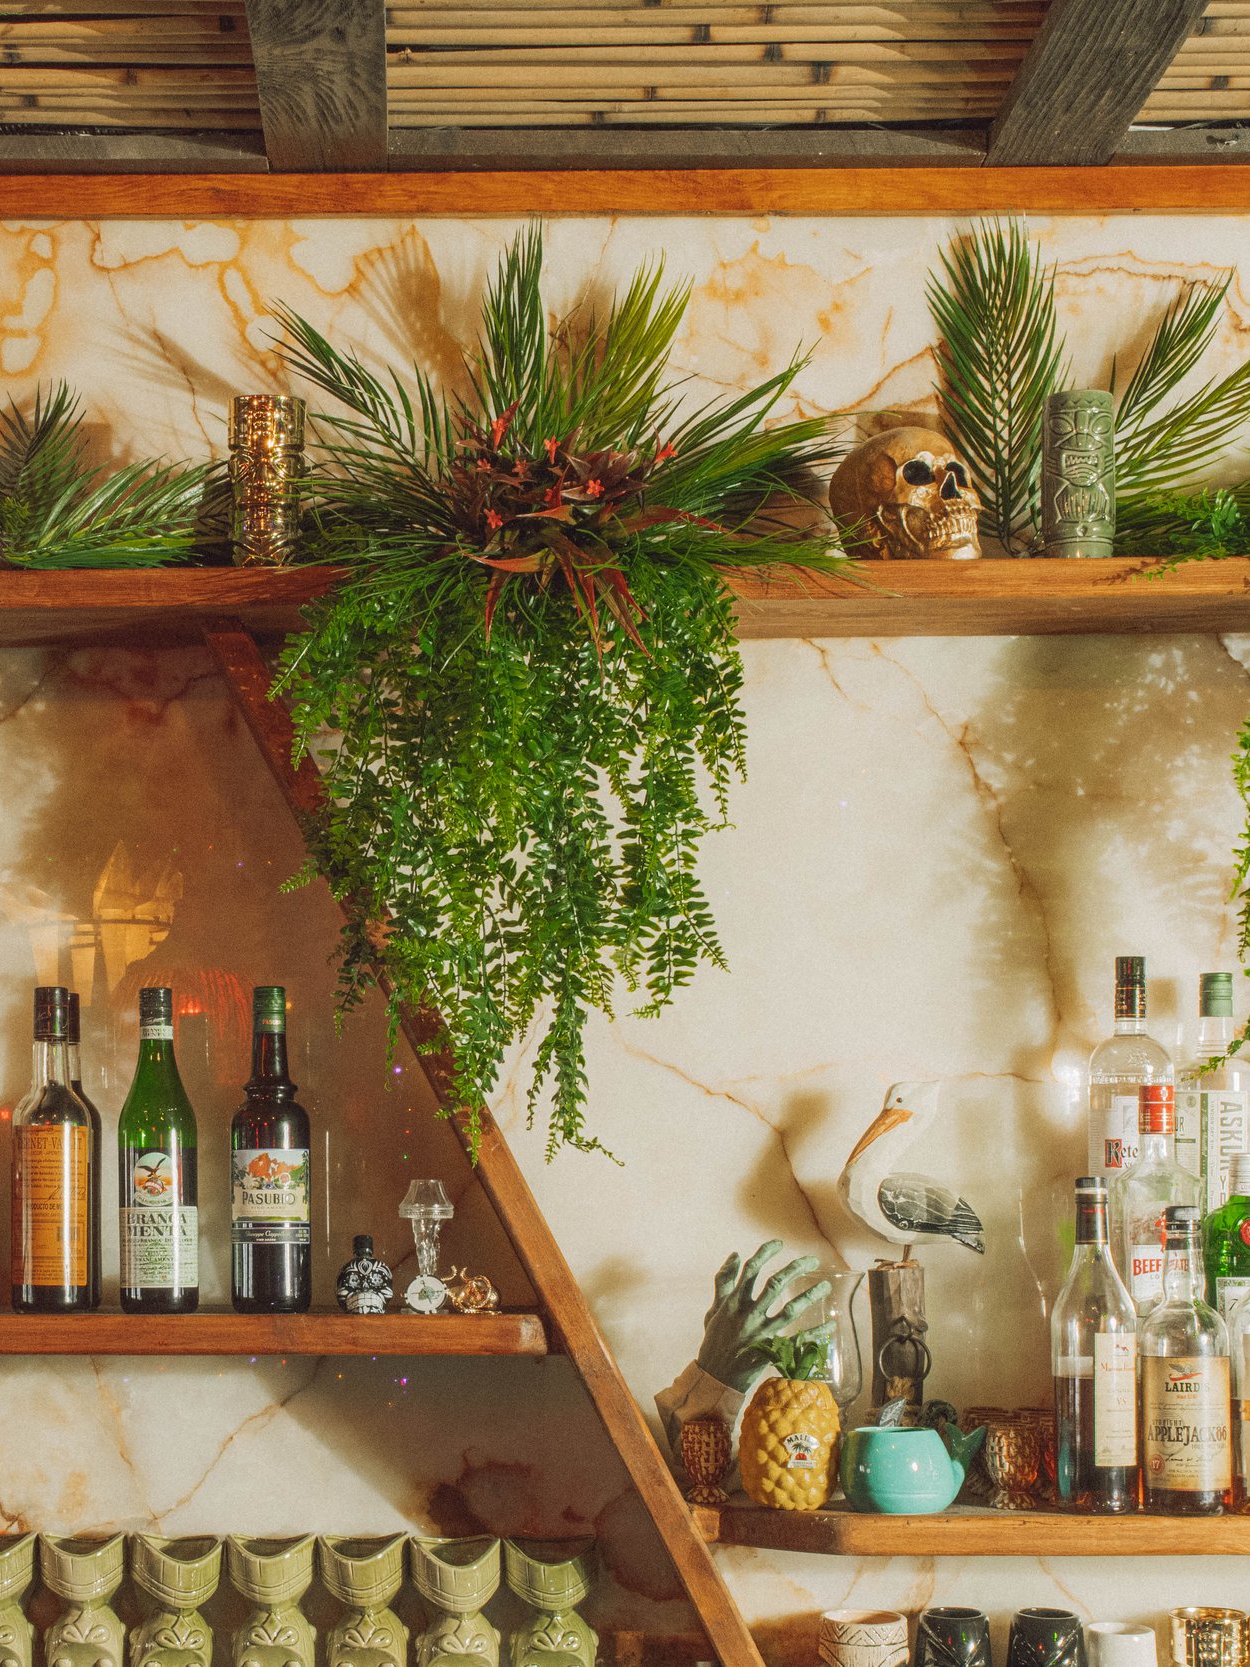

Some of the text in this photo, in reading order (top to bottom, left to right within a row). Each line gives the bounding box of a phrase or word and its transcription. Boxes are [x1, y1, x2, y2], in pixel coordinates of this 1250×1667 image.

[1106, 1140, 1138, 1167] Kete
[242, 1191, 296, 1206] PASUBIO
[126, 1213, 187, 1225] BRANCA
[787, 1434, 816, 1444] MALI
